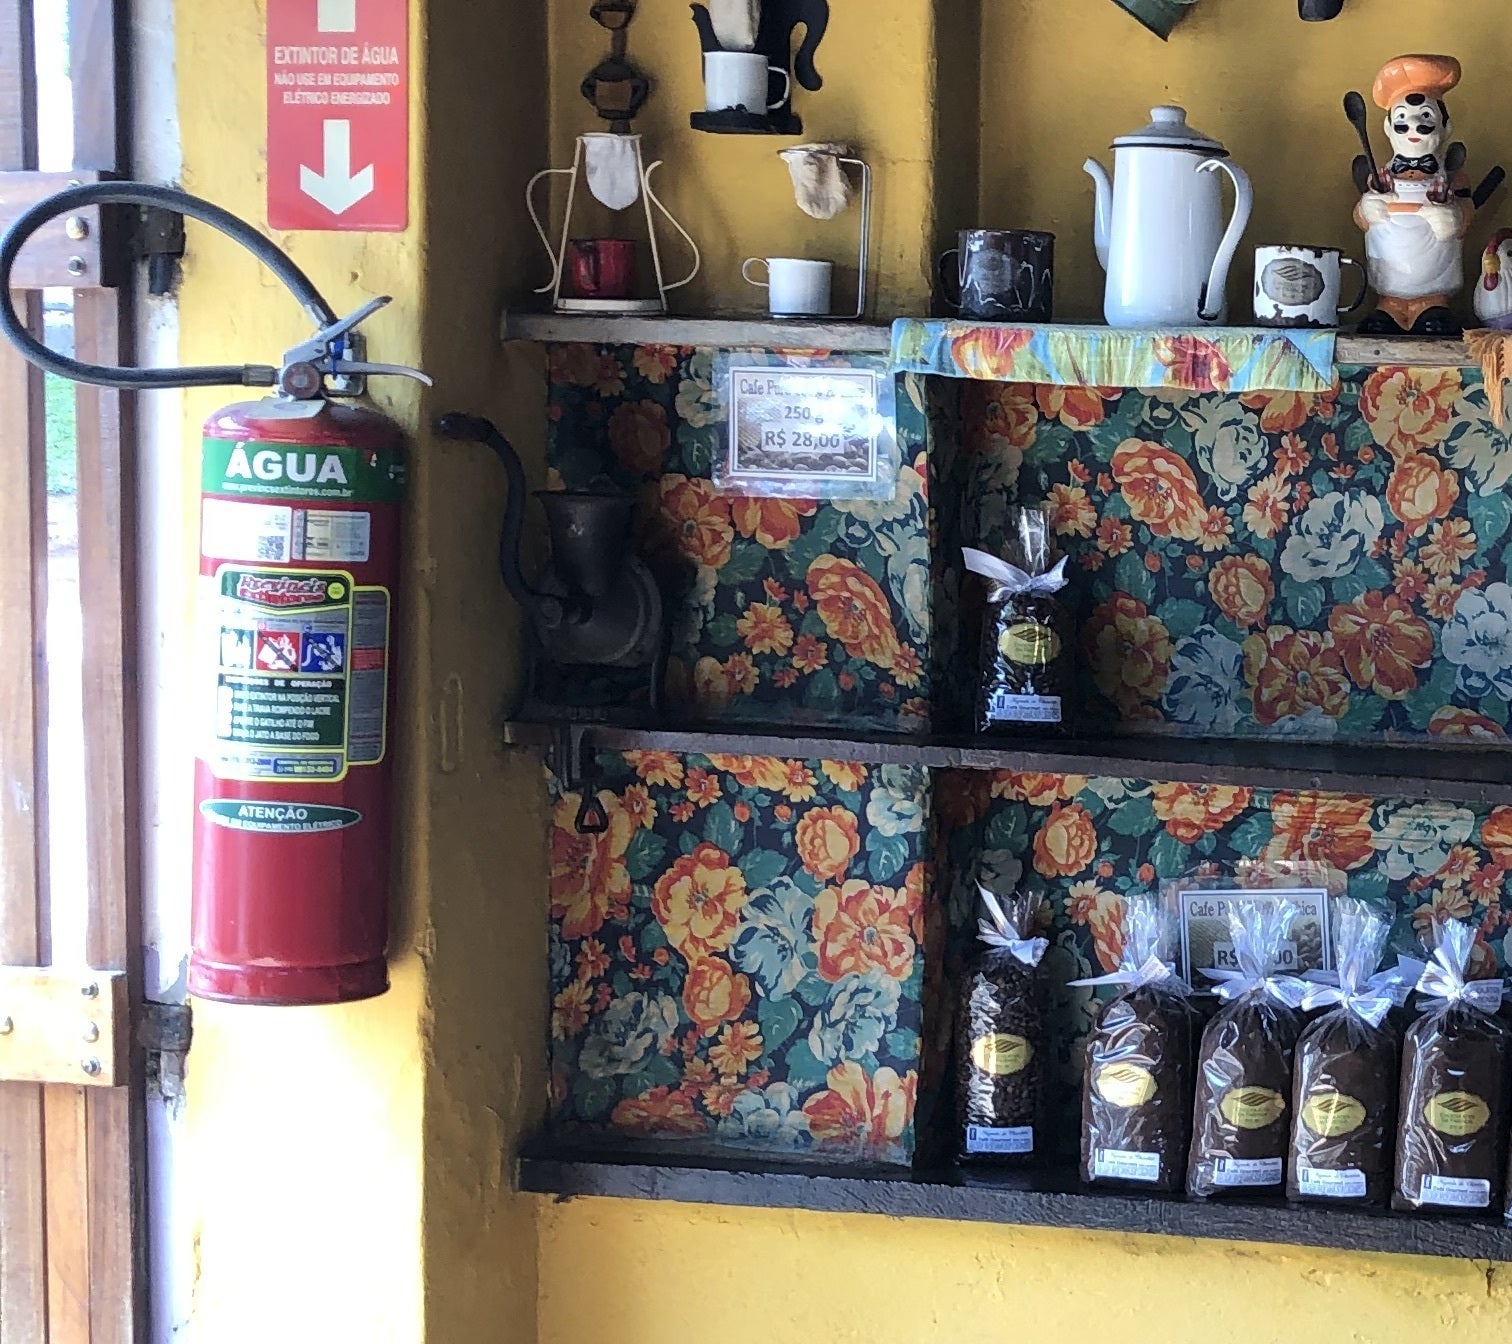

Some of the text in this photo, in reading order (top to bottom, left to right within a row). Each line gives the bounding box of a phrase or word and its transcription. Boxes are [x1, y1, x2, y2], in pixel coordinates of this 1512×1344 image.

[274, 42, 400, 65] EXTINTOR DE ÁGUA
[273, 70, 400, 87] NÃO USE EM EQUIPAMENTO
[283, 88, 391, 105] ELÉTRICO ENERGIZADO
[784, 405, 811, 420] 250
[764, 428, 840, 451] R$ 28,00
[225, 441, 348, 484] ÁGUA
[238, 804, 308, 822] ATENÇÃO
